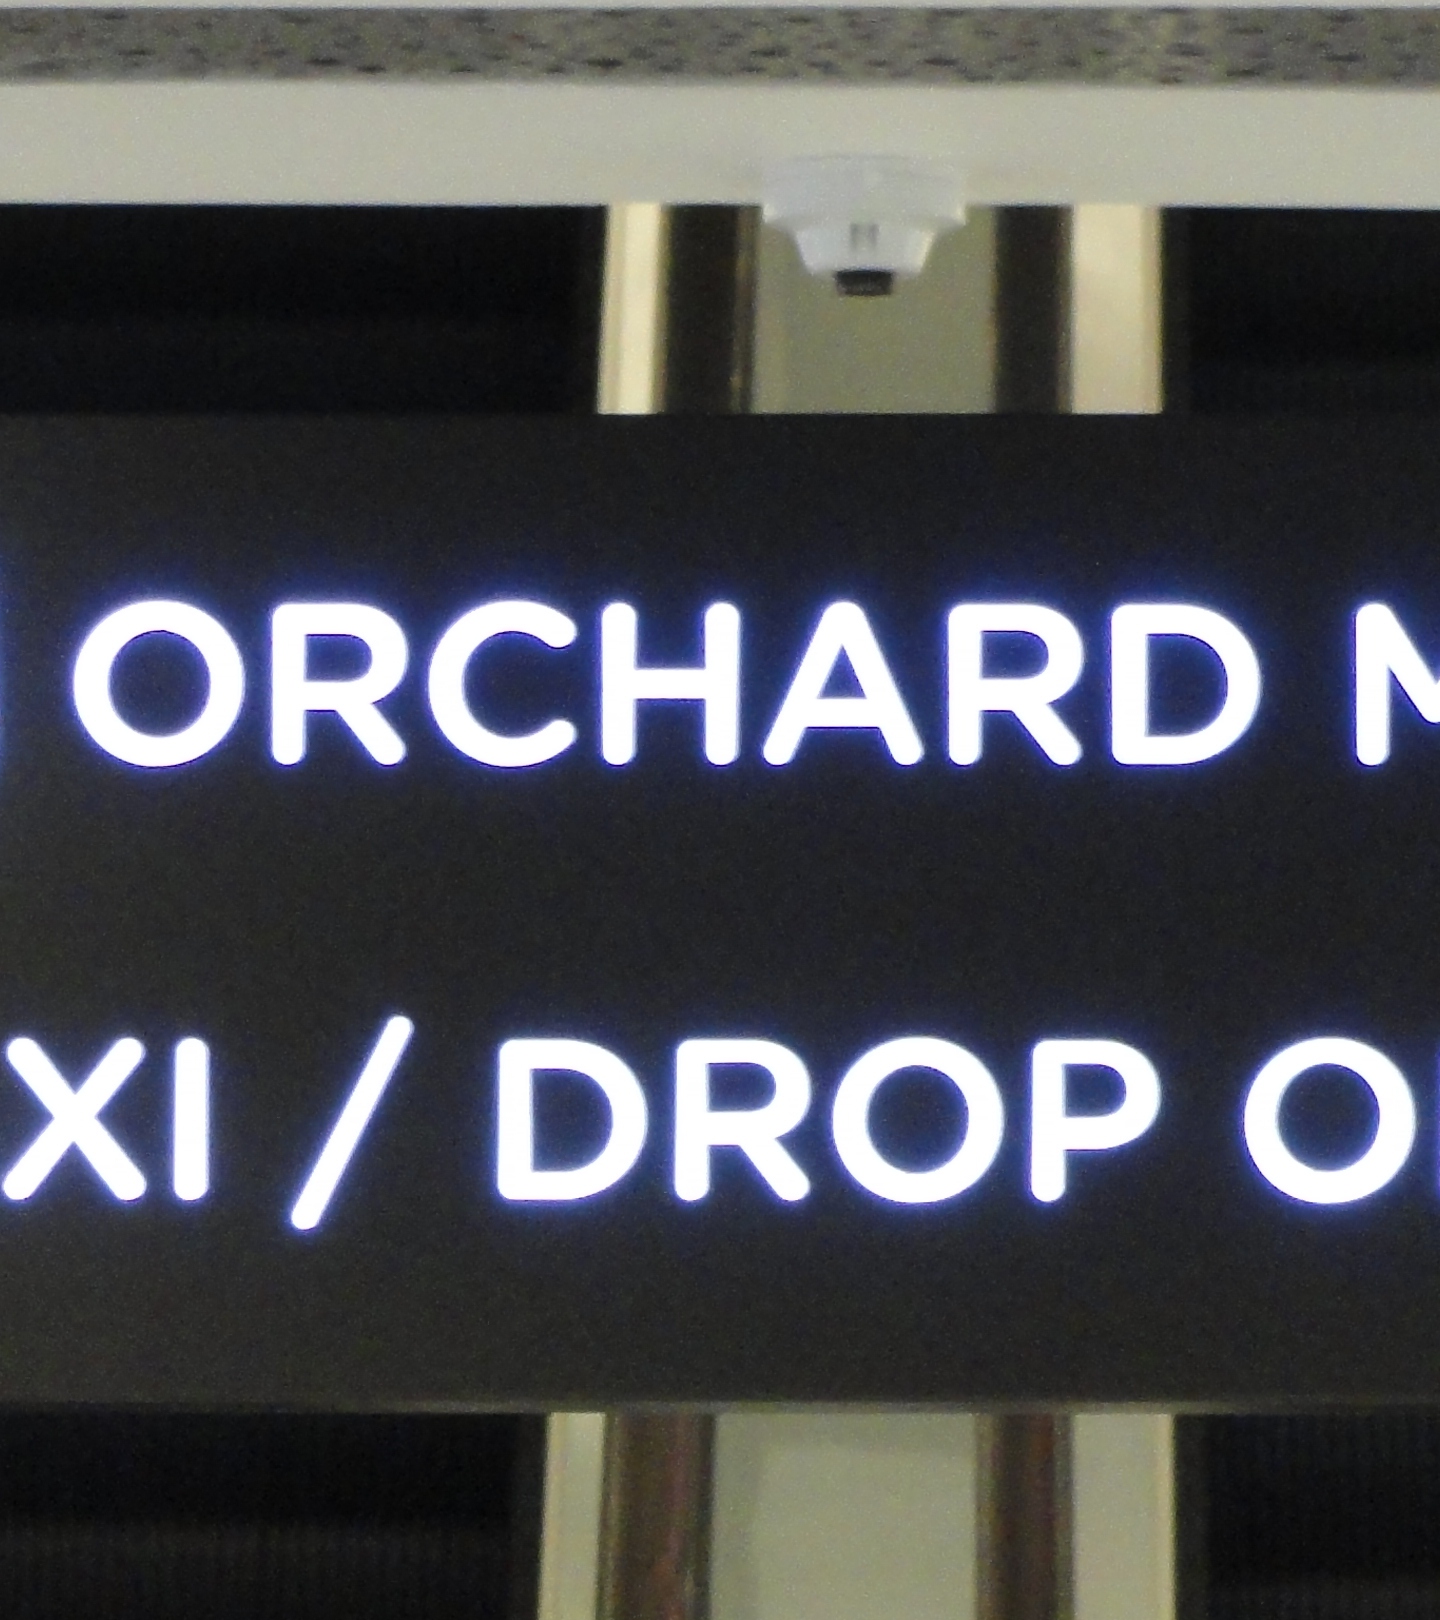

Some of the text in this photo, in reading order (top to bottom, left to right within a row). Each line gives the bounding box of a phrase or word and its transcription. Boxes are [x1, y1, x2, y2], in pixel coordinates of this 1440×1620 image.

[70, 597, 1263, 769] ORCHARD
[289, 1014, 415, 1232] /
[494, 1034, 1164, 1206] DROP
